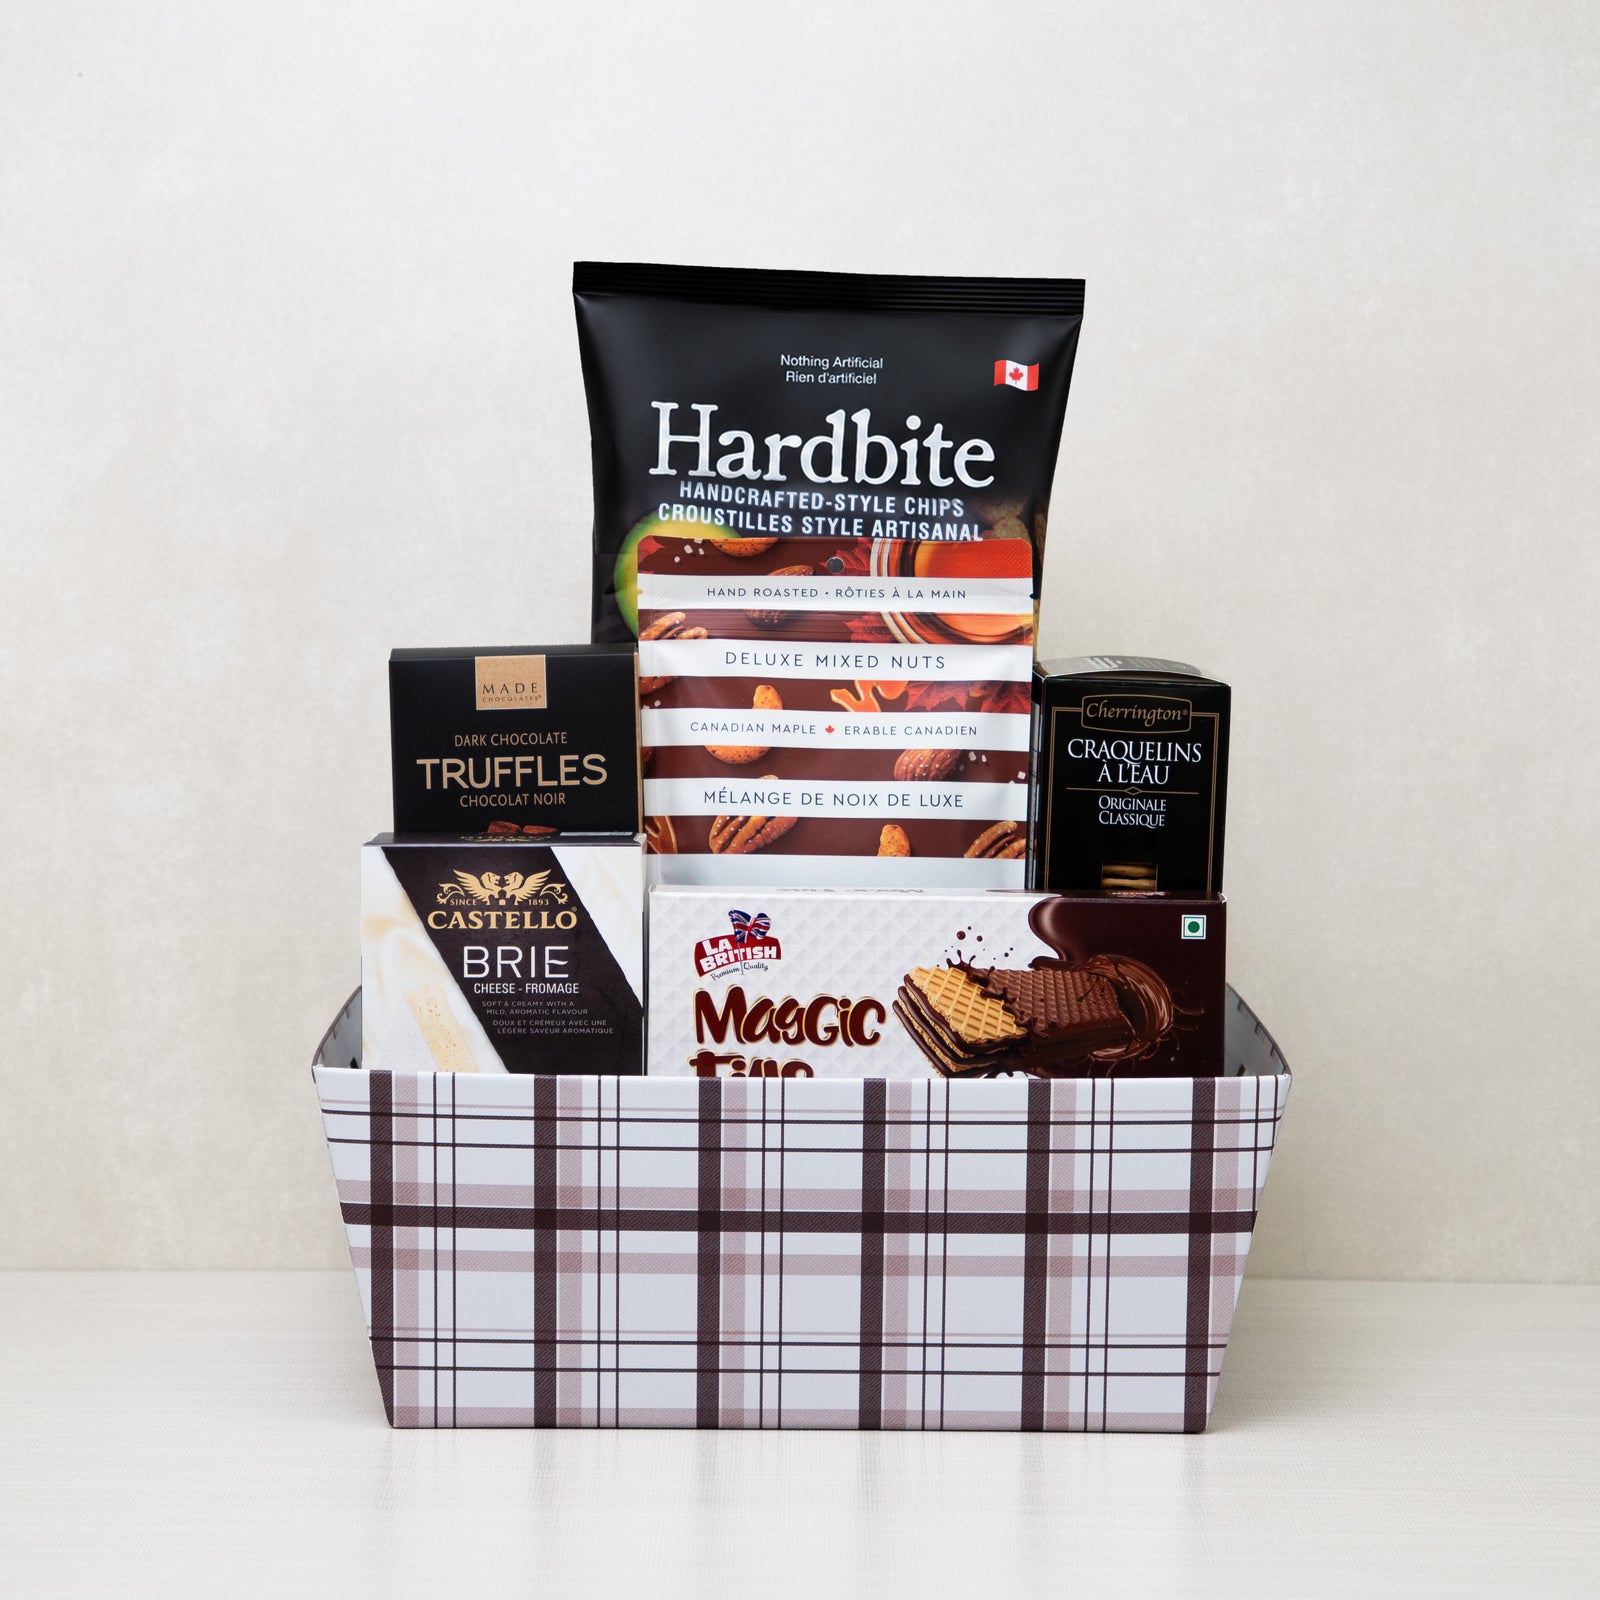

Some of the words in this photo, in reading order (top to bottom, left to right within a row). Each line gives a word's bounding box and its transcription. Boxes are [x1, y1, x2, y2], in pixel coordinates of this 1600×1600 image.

[780, 354, 829, 370] Nothing
[832, 356, 884, 369] Artificial
[786, 371, 814, 382] Rien
[818, 372, 877, 384] d'artificiel
[648, 401, 995, 488] Hardbite
[679, 480, 896, 514] HANDCRAFTED-STYLE
[904, 496, 964, 518] CHIPS
[657, 502, 793, 533] CROUSTILLES
[801, 516, 863, 537] STYLE
[871, 520, 983, 542] ARTISANAL
[706, 587, 748, 598] HAND
[753, 587, 819, 598] ROASTED
[835, 585, 886, 599] RÔTIES
[892, 586, 901, 600] À
[907, 589, 924, 599] LA
[930, 589, 967, 600] MAIN
[725, 651, 804, 667] DELUXE
[815, 654, 880, 669] MIXED
[891, 656, 946, 670] NUTS
[482, 682, 539, 695] MADE
[454, 733, 487, 747] DARK
[490, 731, 568, 746] CHOCOLATE
[690, 722, 765, 734] CANADIAN
[772, 724, 817, 736] MAPLE
[844, 725, 897, 737] ERABLE
[904, 725, 978, 737] CANADIEN
[1067, 738, 1203, 765] CRAQUELINS
[416, 754, 608, 790] TRUFFLES
[1097, 760, 1113, 783] À
[1118, 763, 1170, 785] L'EAU
[459, 793, 530, 808] CHOCOLAT
[533, 792, 566, 805] NOIR
[703, 786, 792, 806] MÉLANGE
[801, 793, 824, 806] DE
[833, 794, 878, 807] NOIX
[888, 794, 911, 807] DE
[920, 795, 964, 808] LUXE
[702, 938, 733, 957] LA
[463, 946, 569, 978] BRIE
[700, 946, 777, 973] BRITISH
[710, 966, 740, 980] Premium
[743, 961, 769, 972] Quality
[473, 983, 516, 994] CHEESE
[525, 983, 579, 994] FROMAGE
